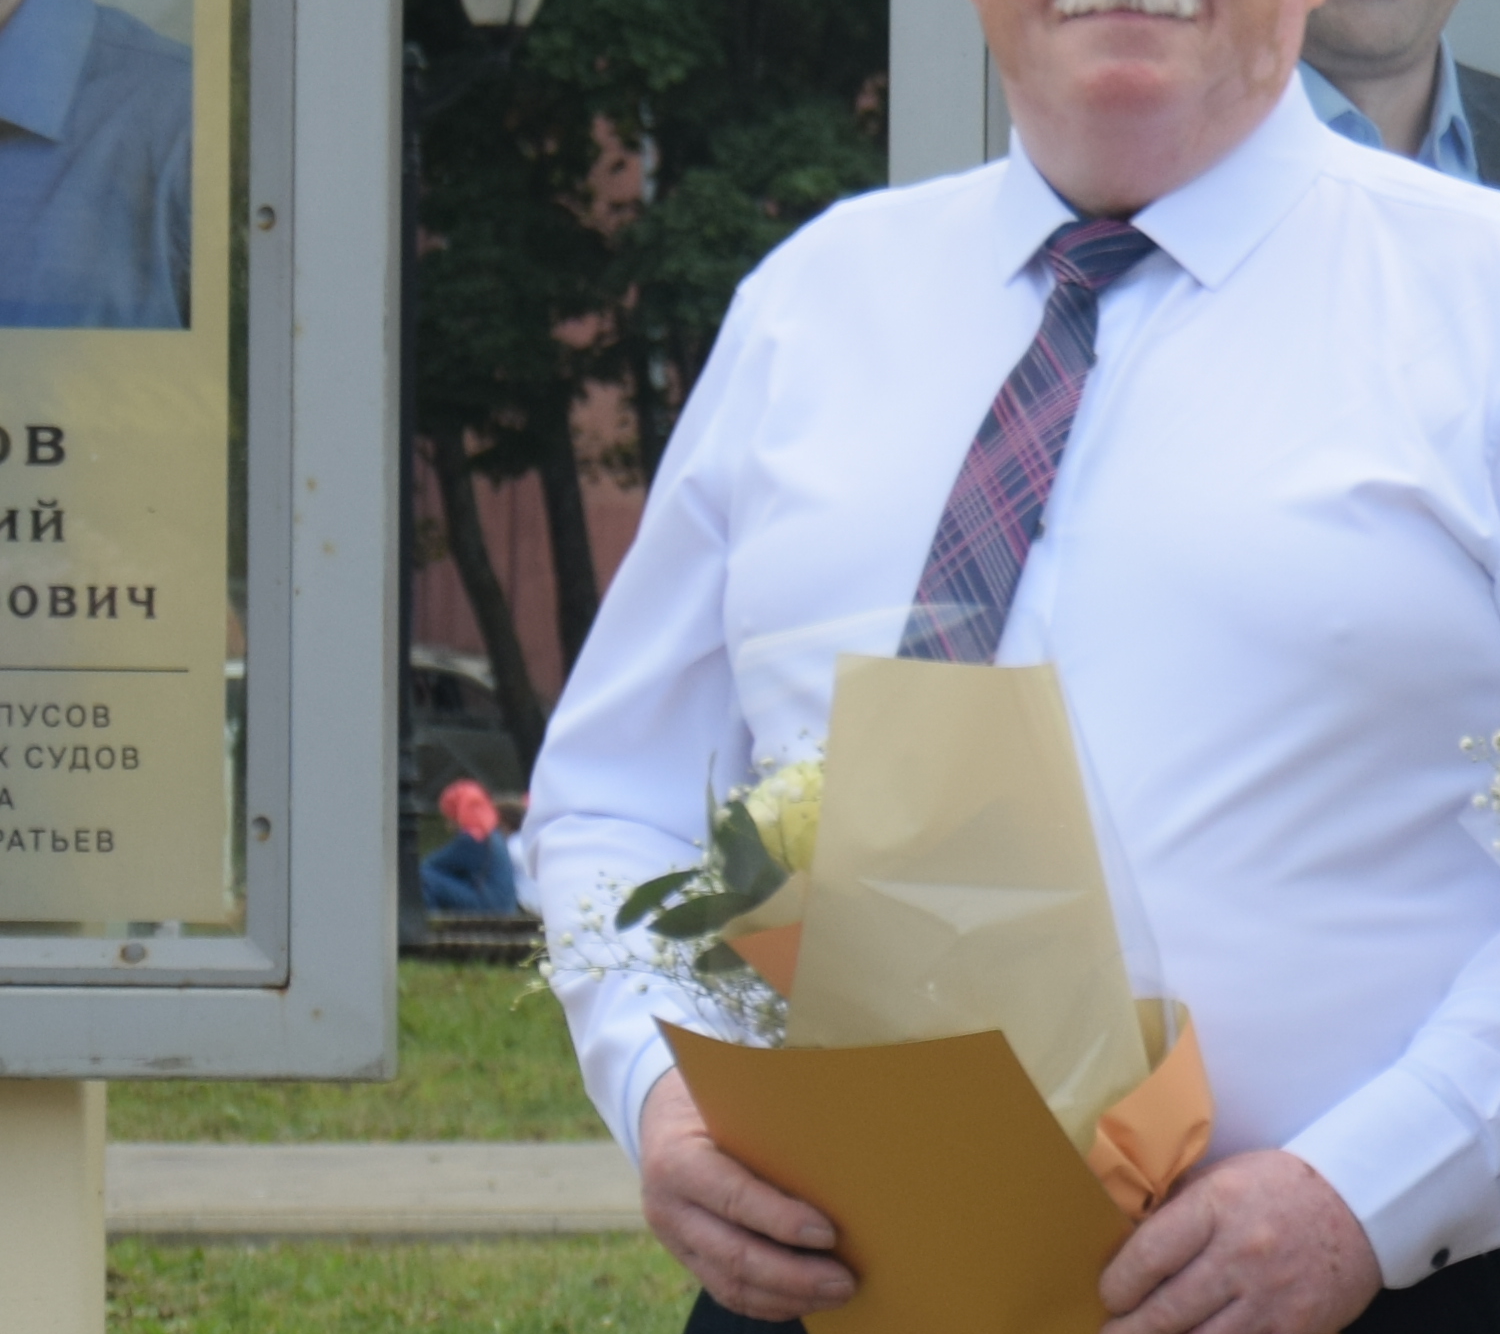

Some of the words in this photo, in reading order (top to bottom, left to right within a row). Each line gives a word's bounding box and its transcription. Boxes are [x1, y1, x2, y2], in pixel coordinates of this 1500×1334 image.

[0, 425, 66, 466] В
[8, 584, 156, 620] ОВИЧ
[24, 745, 139, 772] СУДОВ
[0, 828, 114, 853] АТЬЕВ
